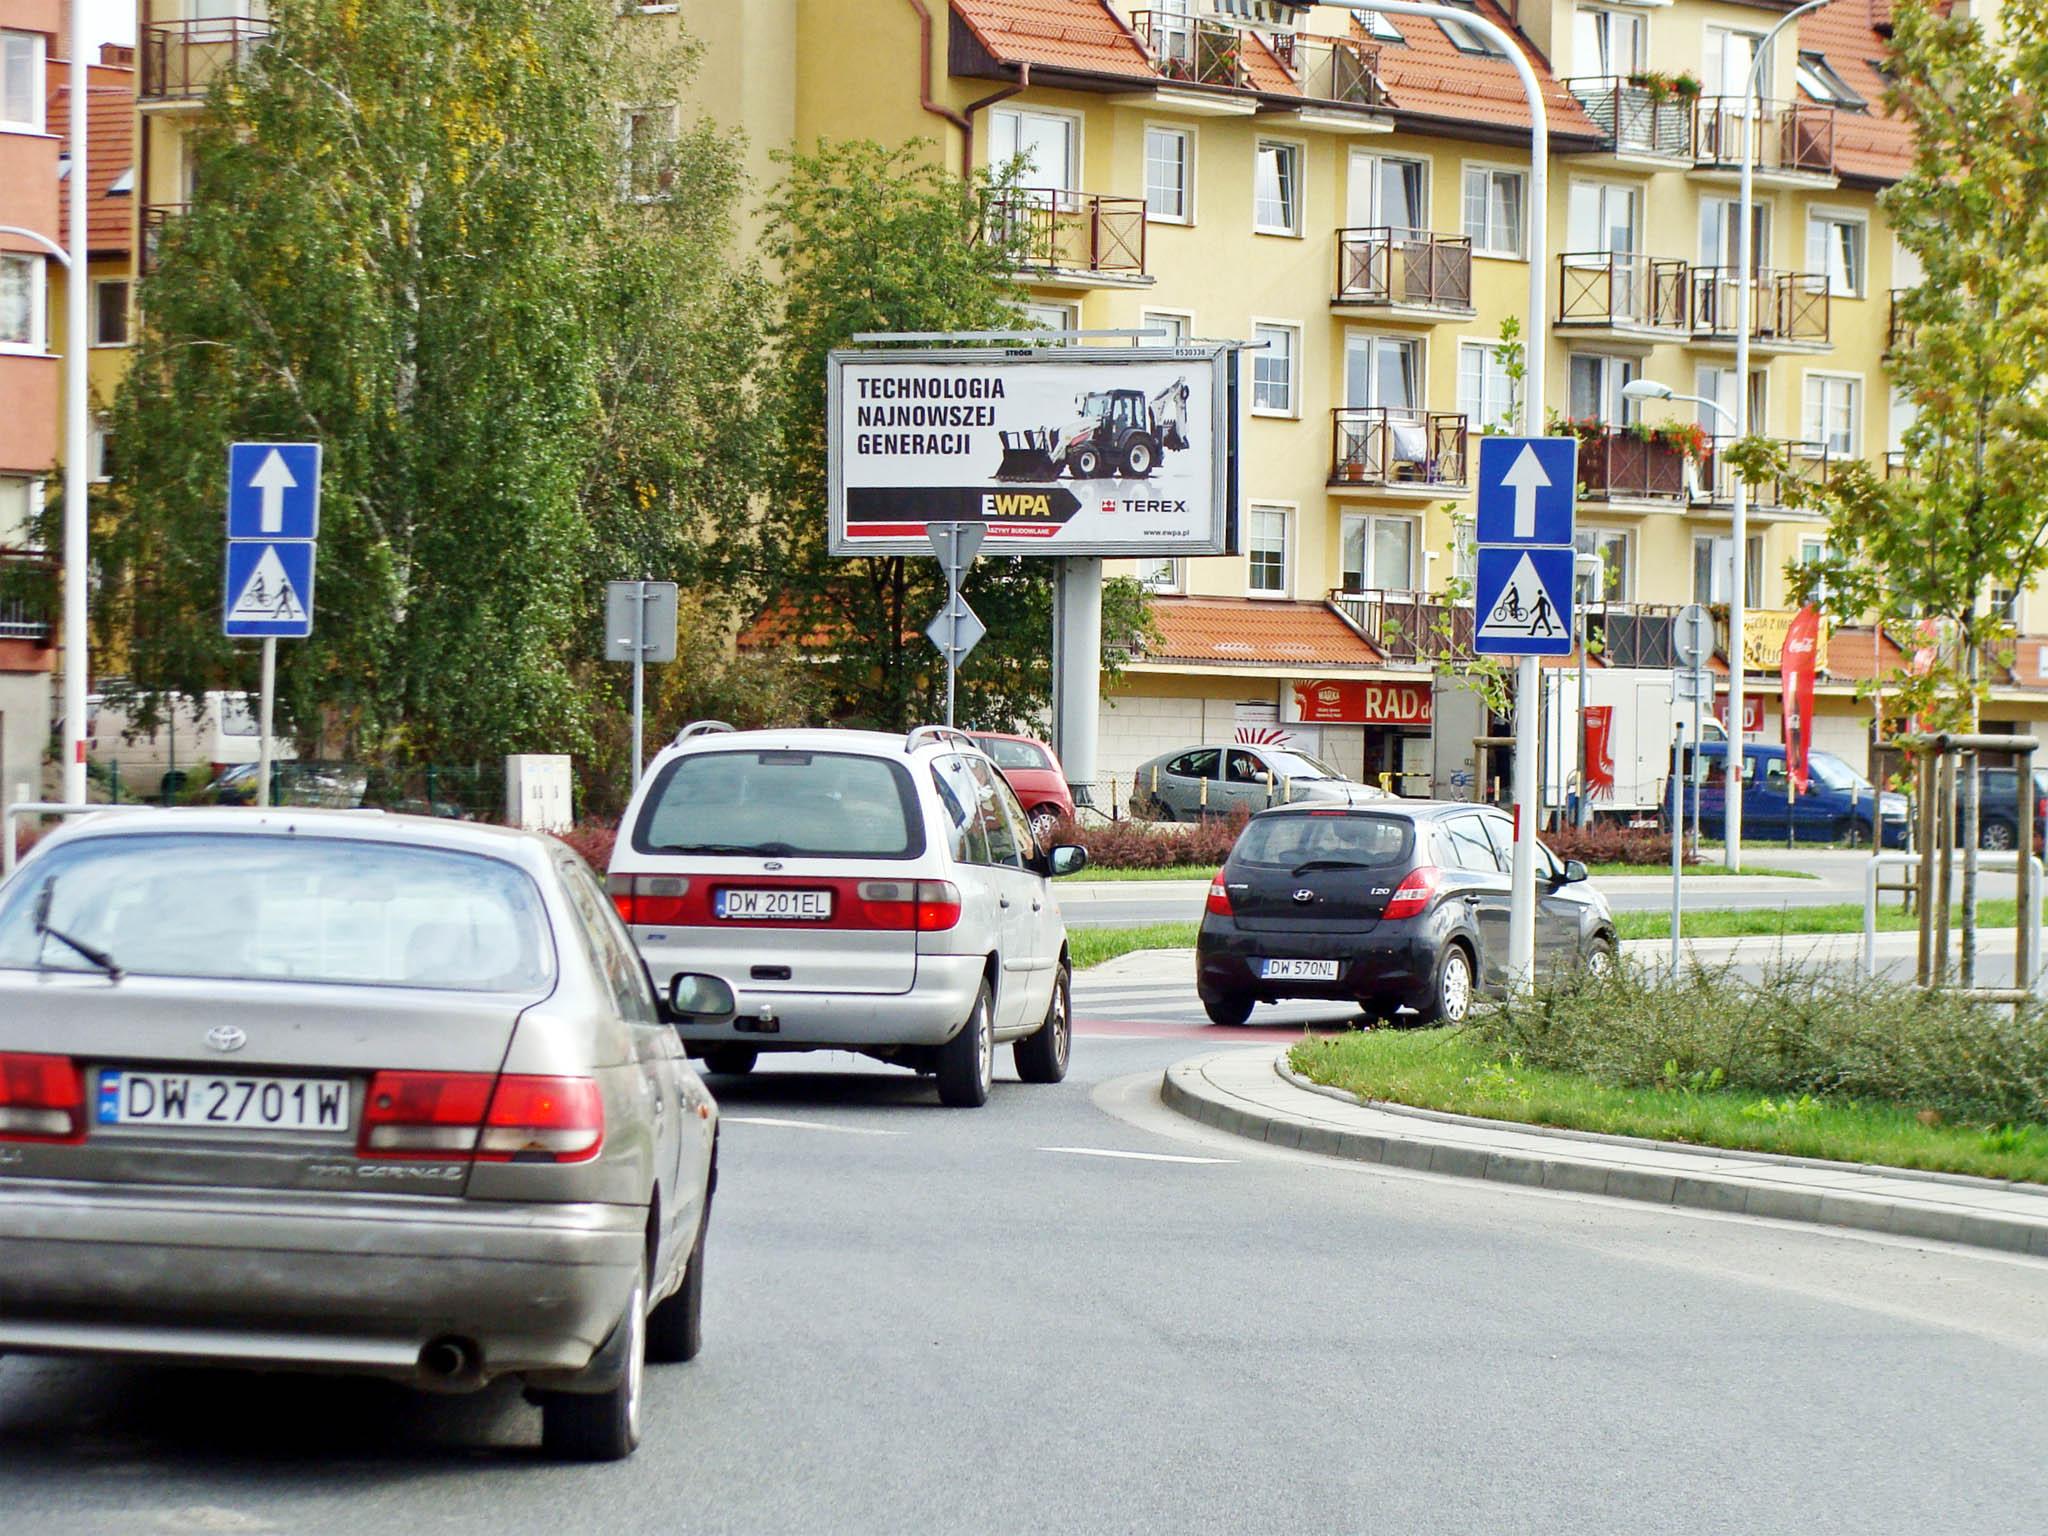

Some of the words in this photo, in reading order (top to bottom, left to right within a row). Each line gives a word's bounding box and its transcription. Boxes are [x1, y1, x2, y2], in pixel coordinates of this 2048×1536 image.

[857, 378, 1005, 399] TECHNOLOGIA
[857, 406, 996, 427] NAJNOWSZEJ
[857, 434, 971, 455] GENERACJI
[981, 494, 1051, 517] EWPA
[1122, 500, 1187, 513] TEREX
[1143, 529, 1190, 537] www.ewpa.pl
[1365, 687, 1419, 720] RAD
[729, 893, 758, 912] DW
[766, 893, 826, 913] 201EL
[1270, 960, 1291, 975] DW
[1294, 960, 1335, 976] 570NL
[127, 1077, 190, 1119] DW
[206, 1080, 343, 1125] 2701W
